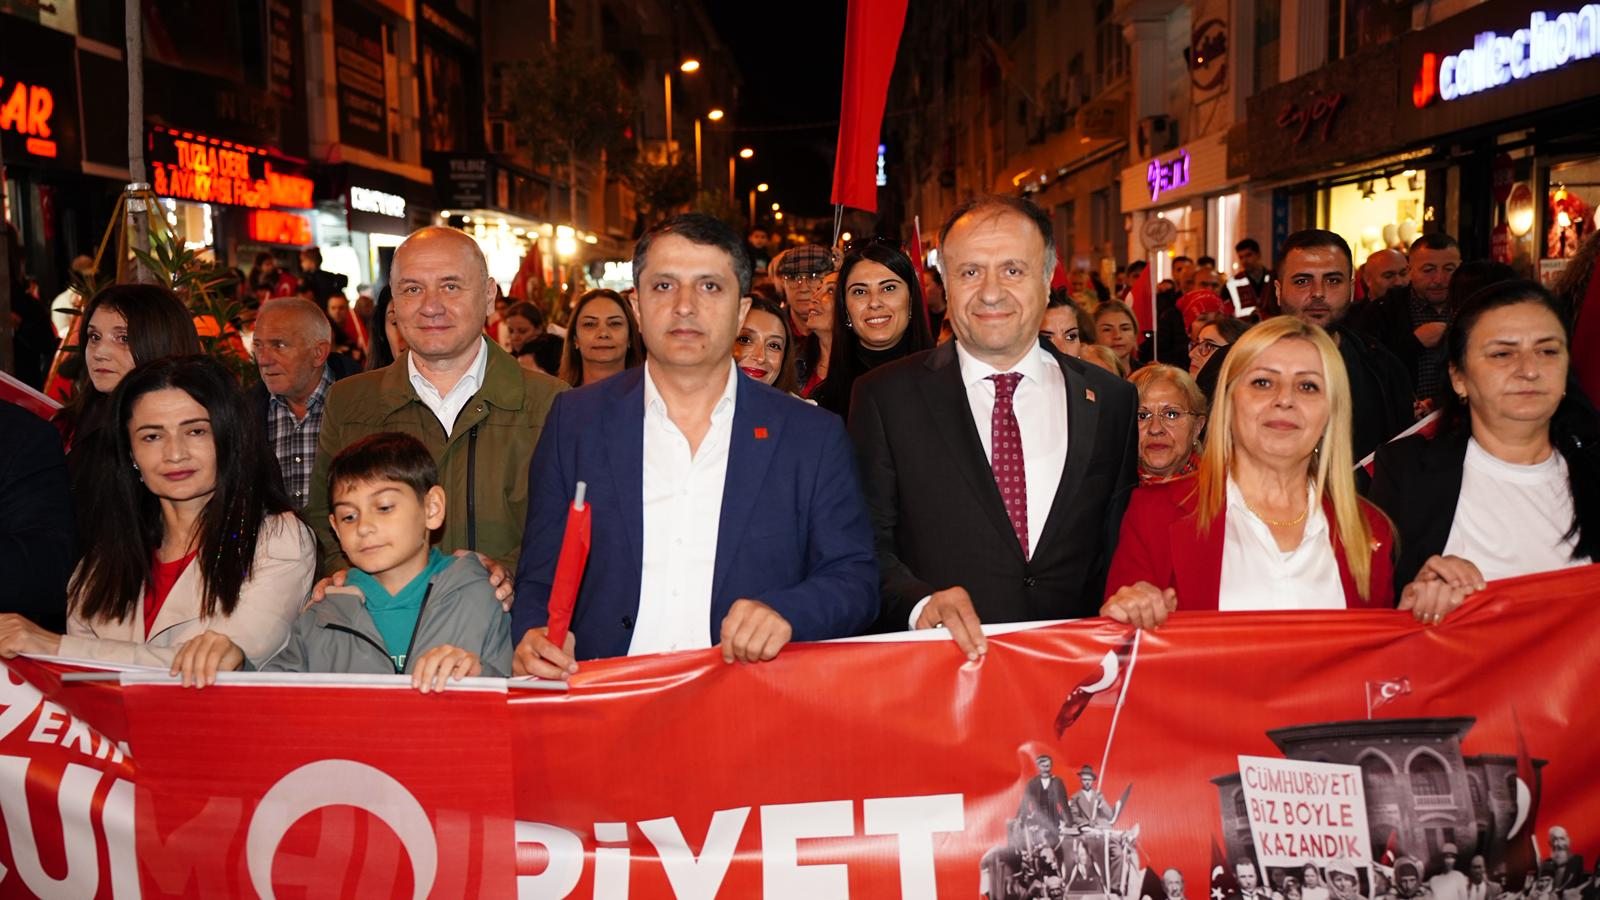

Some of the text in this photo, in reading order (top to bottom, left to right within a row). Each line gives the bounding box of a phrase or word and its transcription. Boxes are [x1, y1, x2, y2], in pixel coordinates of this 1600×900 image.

[1412, 4, 1600, 108] J collection
[0, 76, 54, 139] AR
[1245, 766, 1359, 796] CÜMHURİYETİ
[1251, 798, 1354, 827] BİZ BÖYLE
[1259, 831, 1362, 859] KAZANDIK
